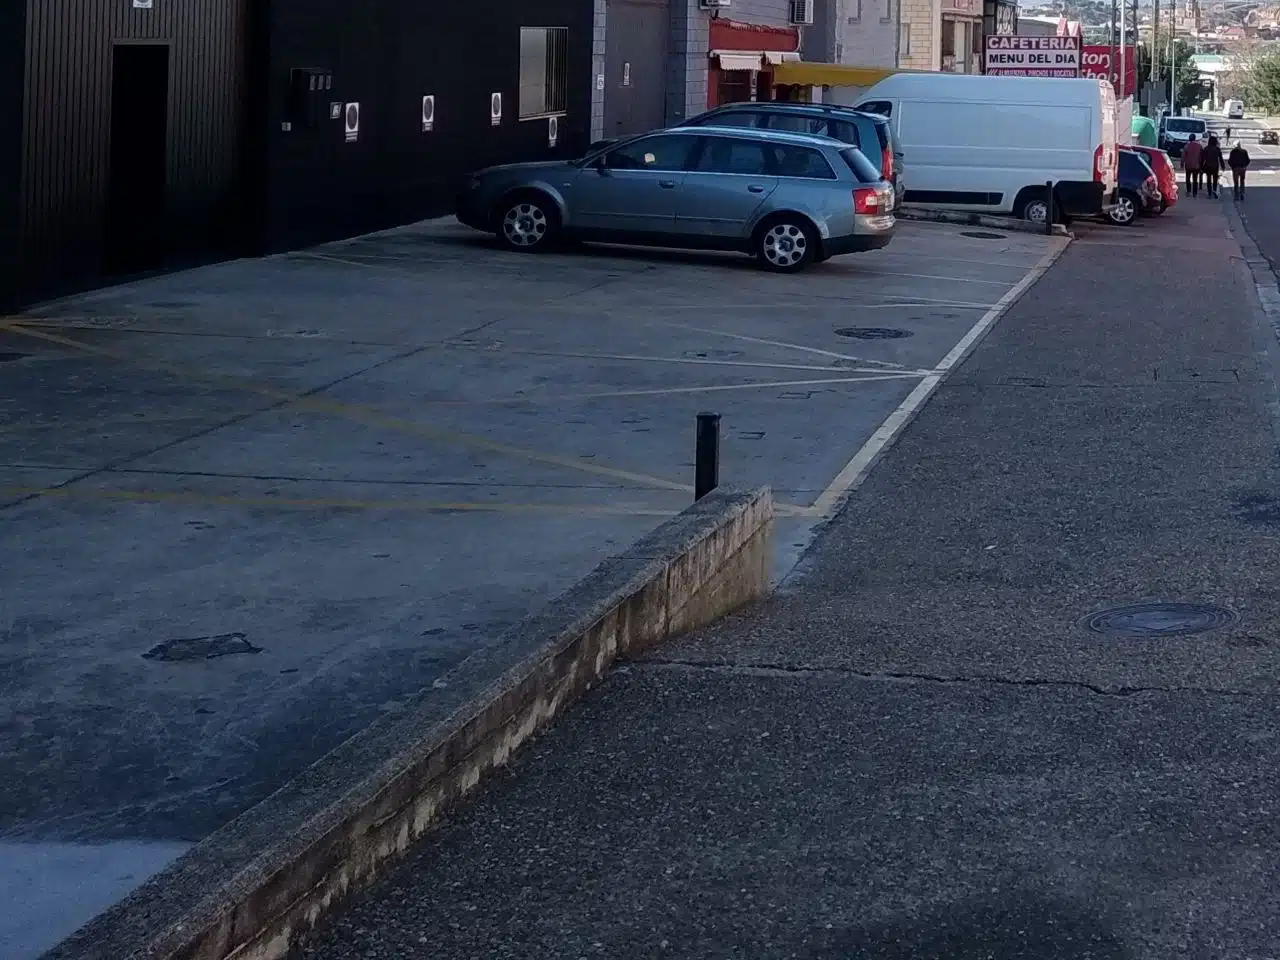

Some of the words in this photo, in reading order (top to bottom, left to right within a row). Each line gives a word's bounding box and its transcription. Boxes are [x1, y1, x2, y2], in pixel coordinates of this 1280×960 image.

[988, 37, 1076, 49] CAFETERIA
[989, 54, 1024, 64] MENU
[1028, 54, 1052, 64] DEL
[1055, 54, 1076, 64] DIA
